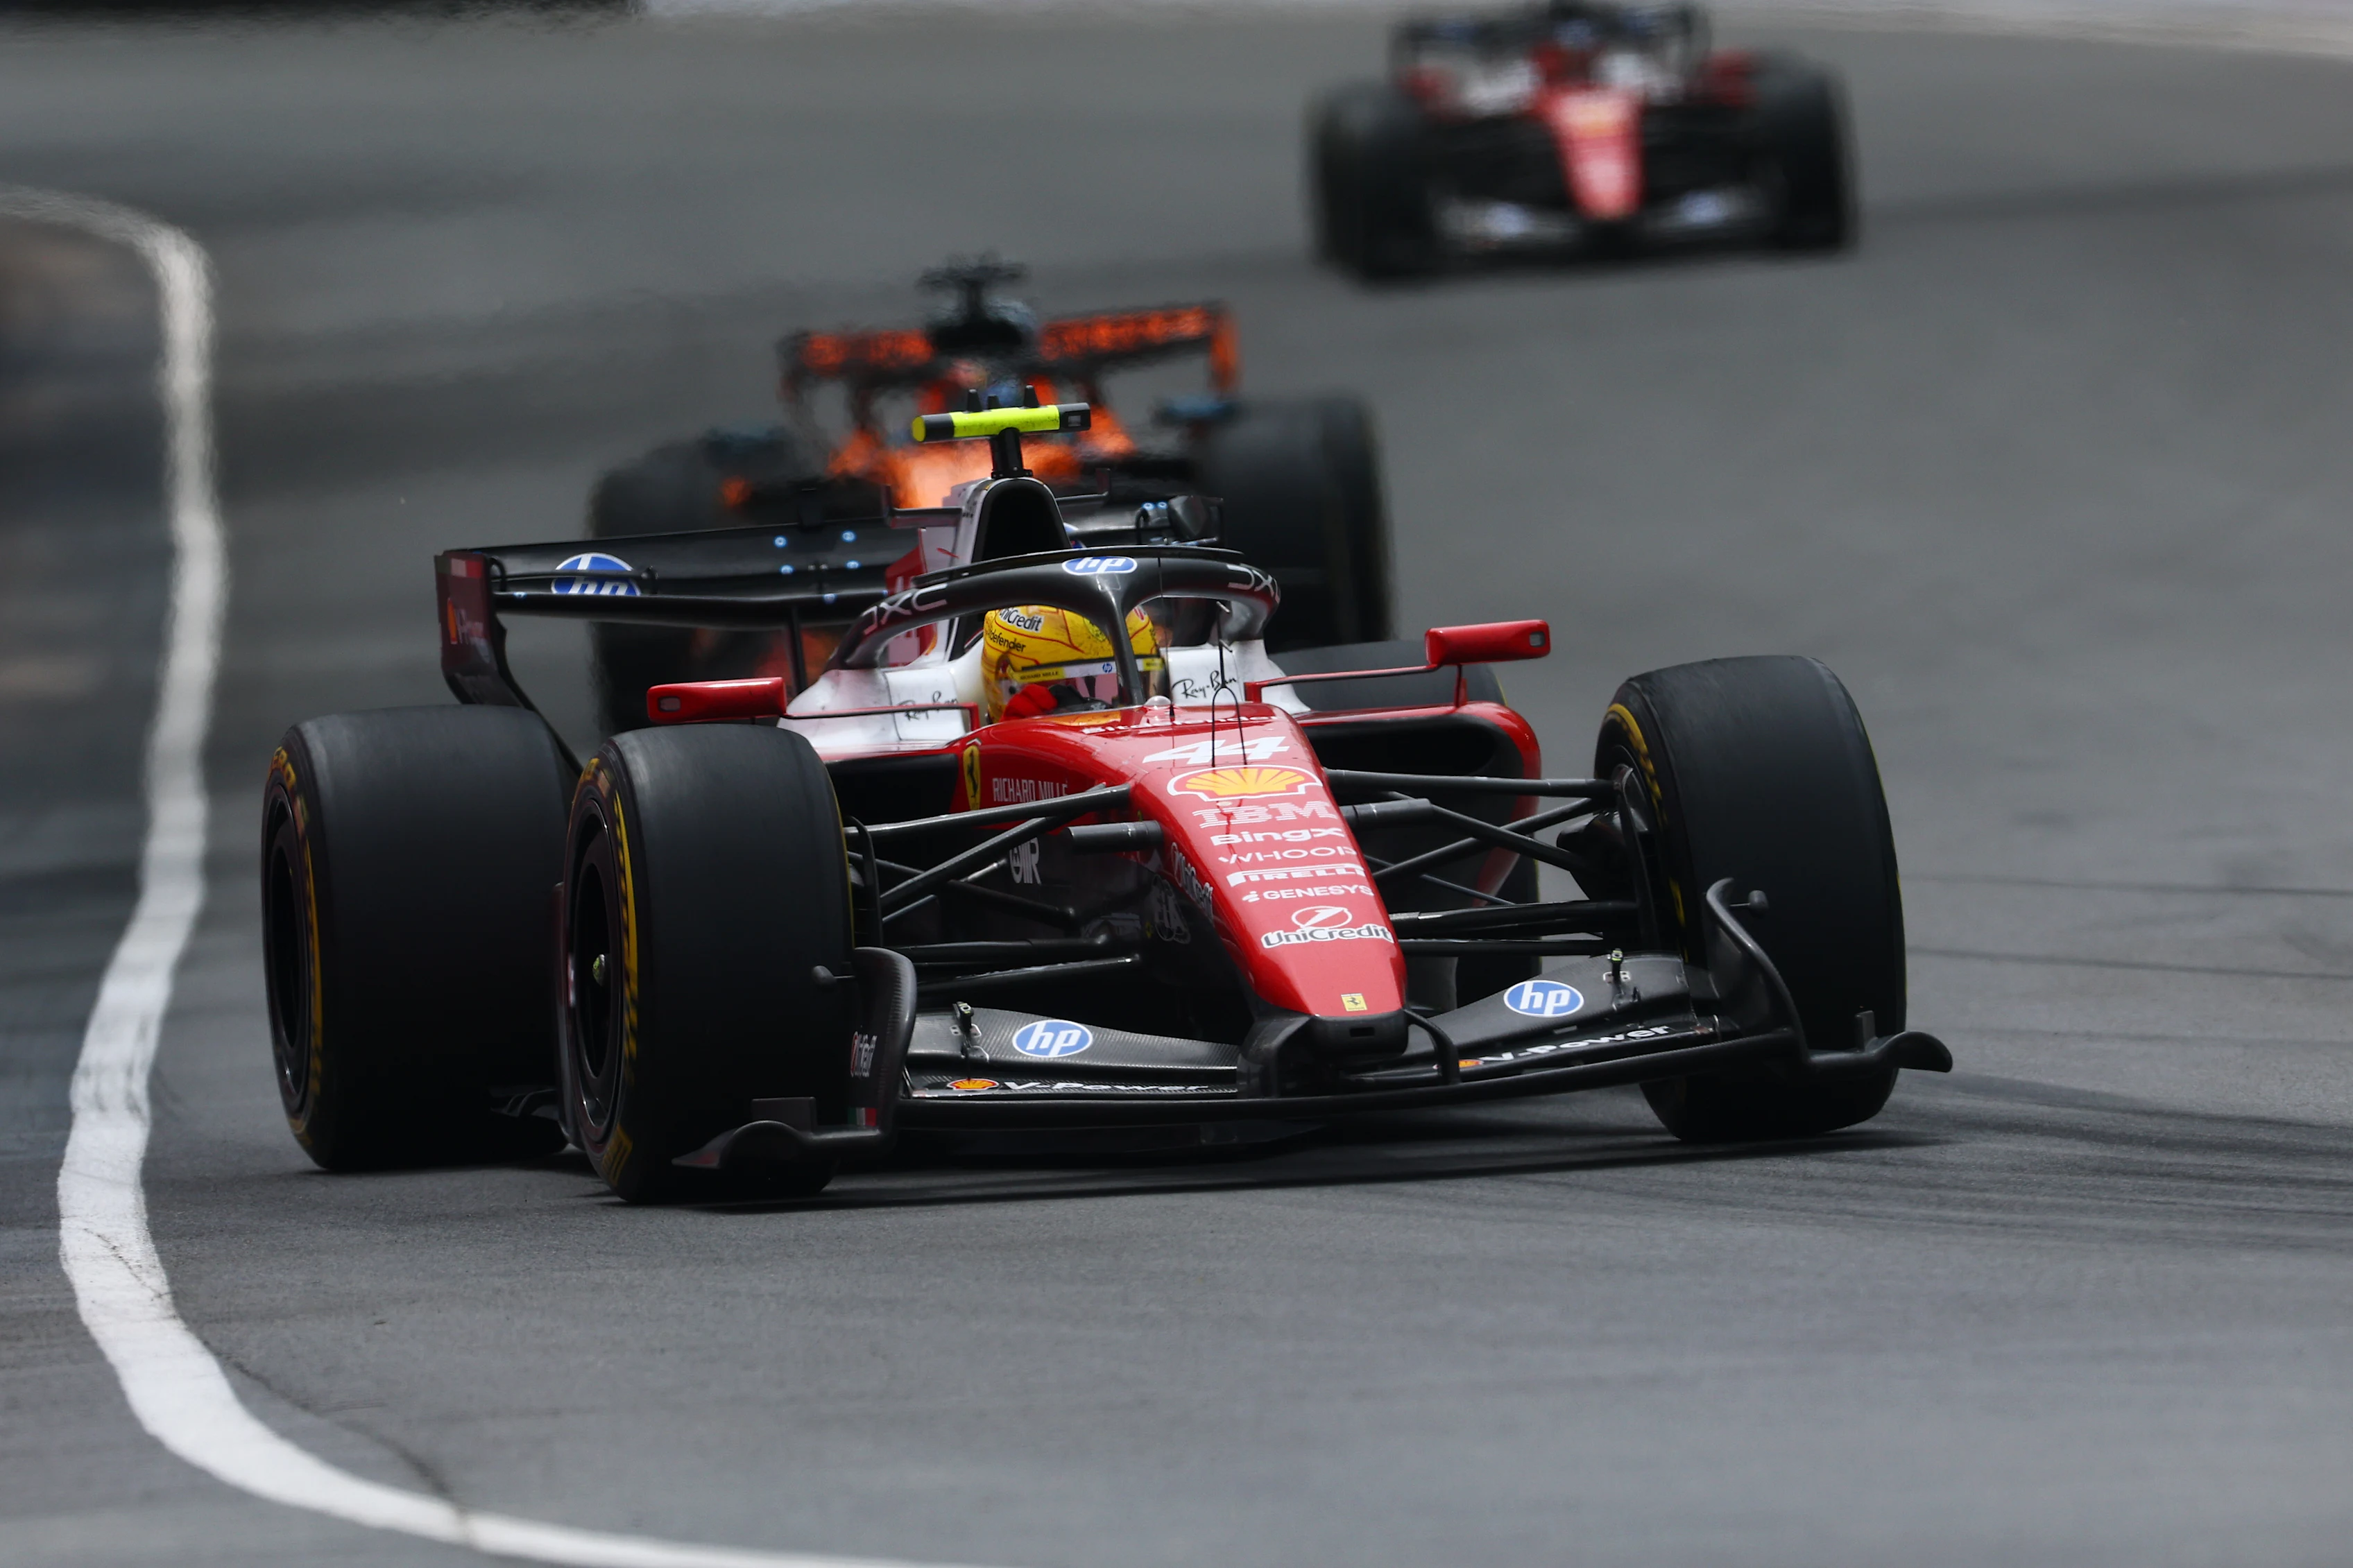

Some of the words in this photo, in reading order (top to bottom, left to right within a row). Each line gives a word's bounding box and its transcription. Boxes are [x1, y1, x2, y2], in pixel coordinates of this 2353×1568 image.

[1074, 556, 1127, 574] hp
[999, 607, 1043, 632] niCredit
[1103, 662, 1112, 673] hp
[1143, 736, 1290, 765] 44
[993, 777, 1036, 802] RICHARD
[1192, 801, 1339, 829] IBM
[1210, 827, 1346, 847] BingX
[1218, 845, 1358, 865] WHOOP
[1226, 863, 1366, 887] PIRELLI
[1263, 884, 1375, 900] GENESYS
[1265, 924, 1392, 947] UniCredit
[1518, 980, 1571, 1015] hp
[1025, 1020, 1082, 1057] hp
[1480, 1025, 1670, 1062] V-Power
[1004, 1081, 1209, 1091] V-Power
